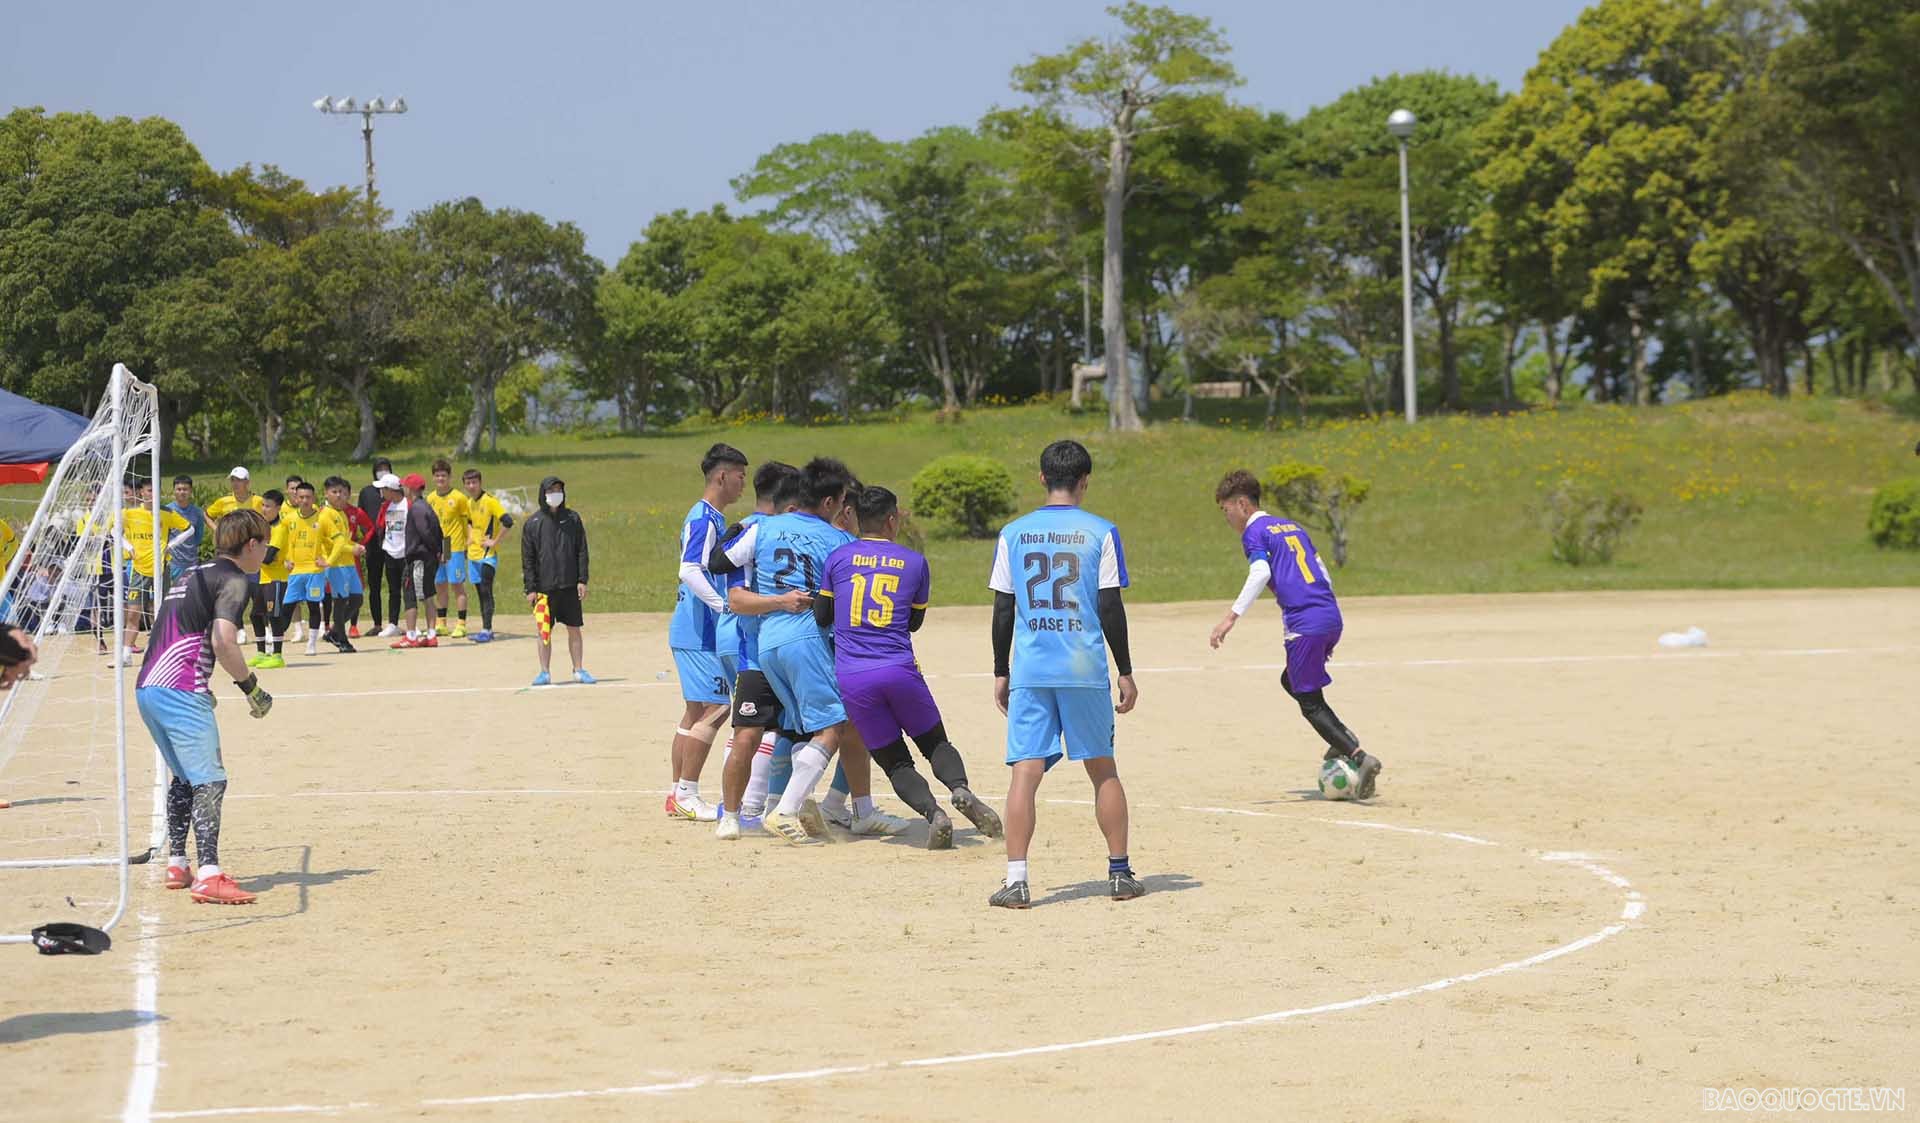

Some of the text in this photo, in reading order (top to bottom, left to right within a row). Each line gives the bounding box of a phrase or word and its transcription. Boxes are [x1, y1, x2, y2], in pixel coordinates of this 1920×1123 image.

[1020, 532, 1044, 544] Khoa
[774, 548, 815, 591] 21
[852, 554, 905, 569] Quý Lee
[1023, 552, 1079, 610] 22
[1284, 535, 1316, 585] 7
[850, 573, 900, 628] 15
[1068, 619, 1082, 631] FC
